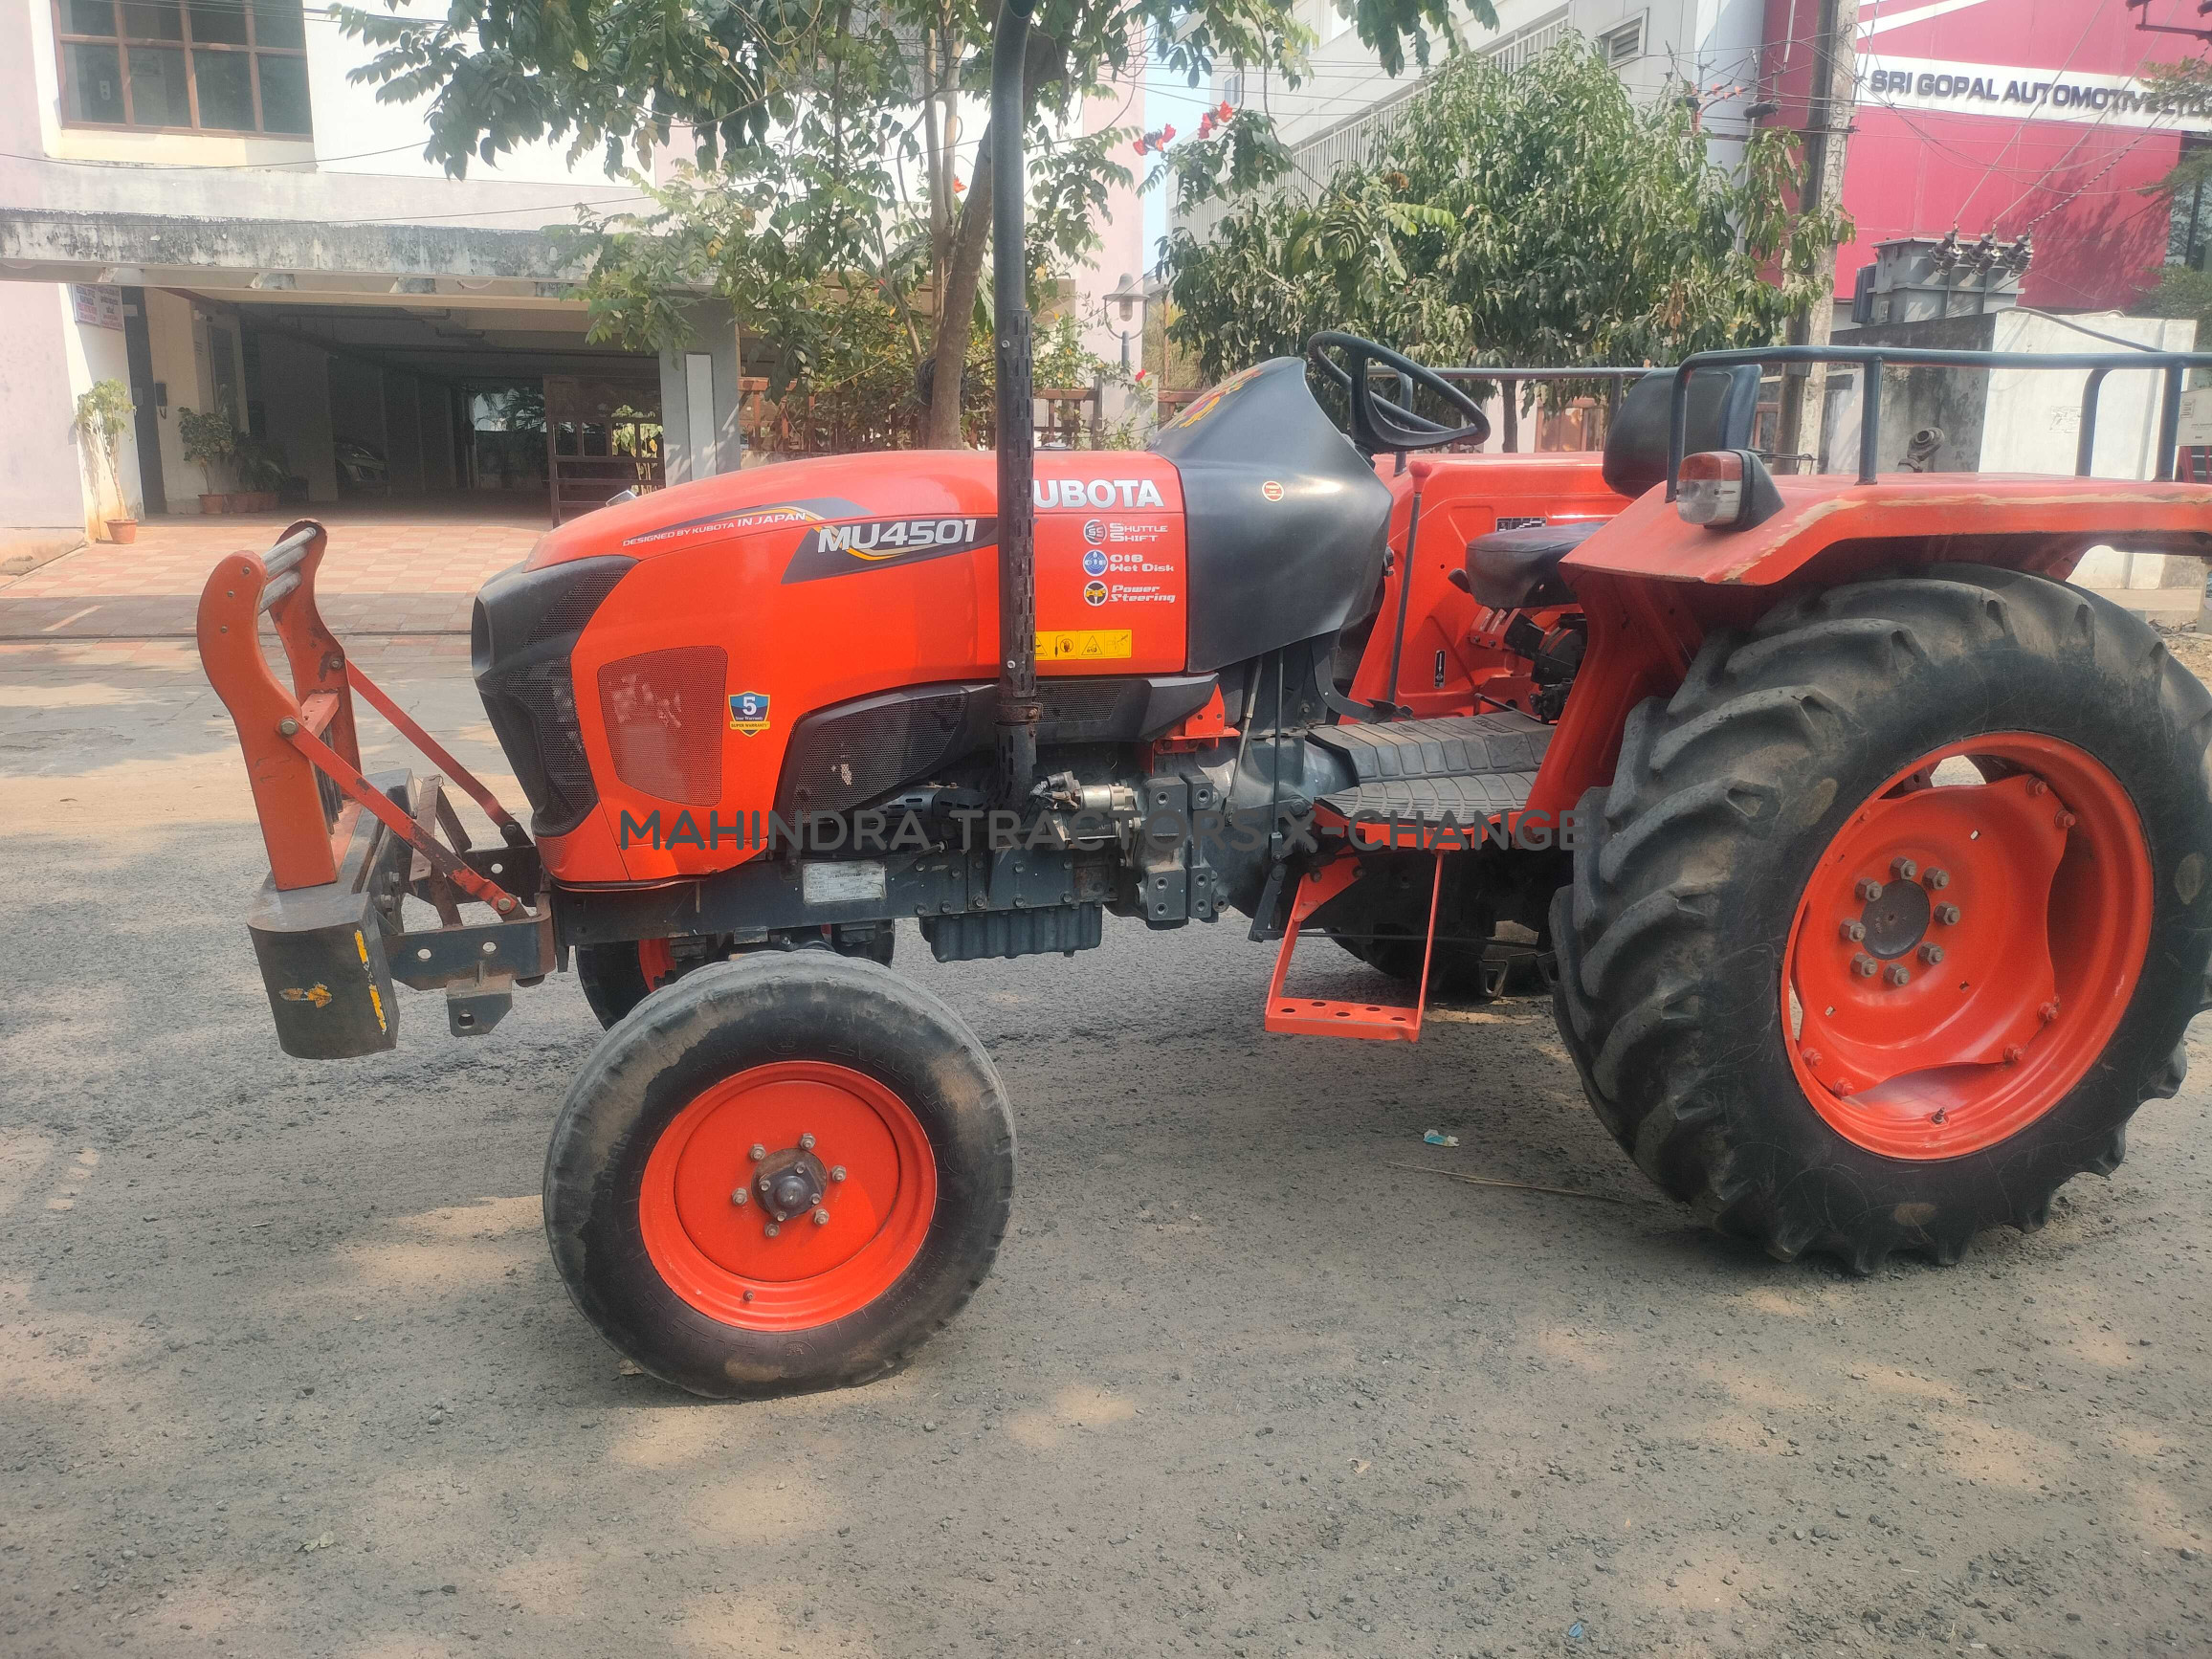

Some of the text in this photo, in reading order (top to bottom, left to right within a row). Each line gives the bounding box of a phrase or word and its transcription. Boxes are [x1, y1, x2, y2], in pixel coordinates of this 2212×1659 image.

[1870, 70, 1913, 95] SRI
[1916, 73, 2000, 100] GOPAL
[1034, 479, 1164, 508] UBOTA
[623, 531, 675, 546] DESIGNED
[692, 522, 734, 534] KUBOTA
[737, 518, 753, 527] IN
[754, 513, 806, 525] JAPAN
[817, 520, 977, 553] MU4501
[1110, 564, 1174, 572] Wet Disk
[1109, 593, 1176, 604] Steering
[1112, 585, 1160, 593] Power
[742, 696, 757, 716] 5
